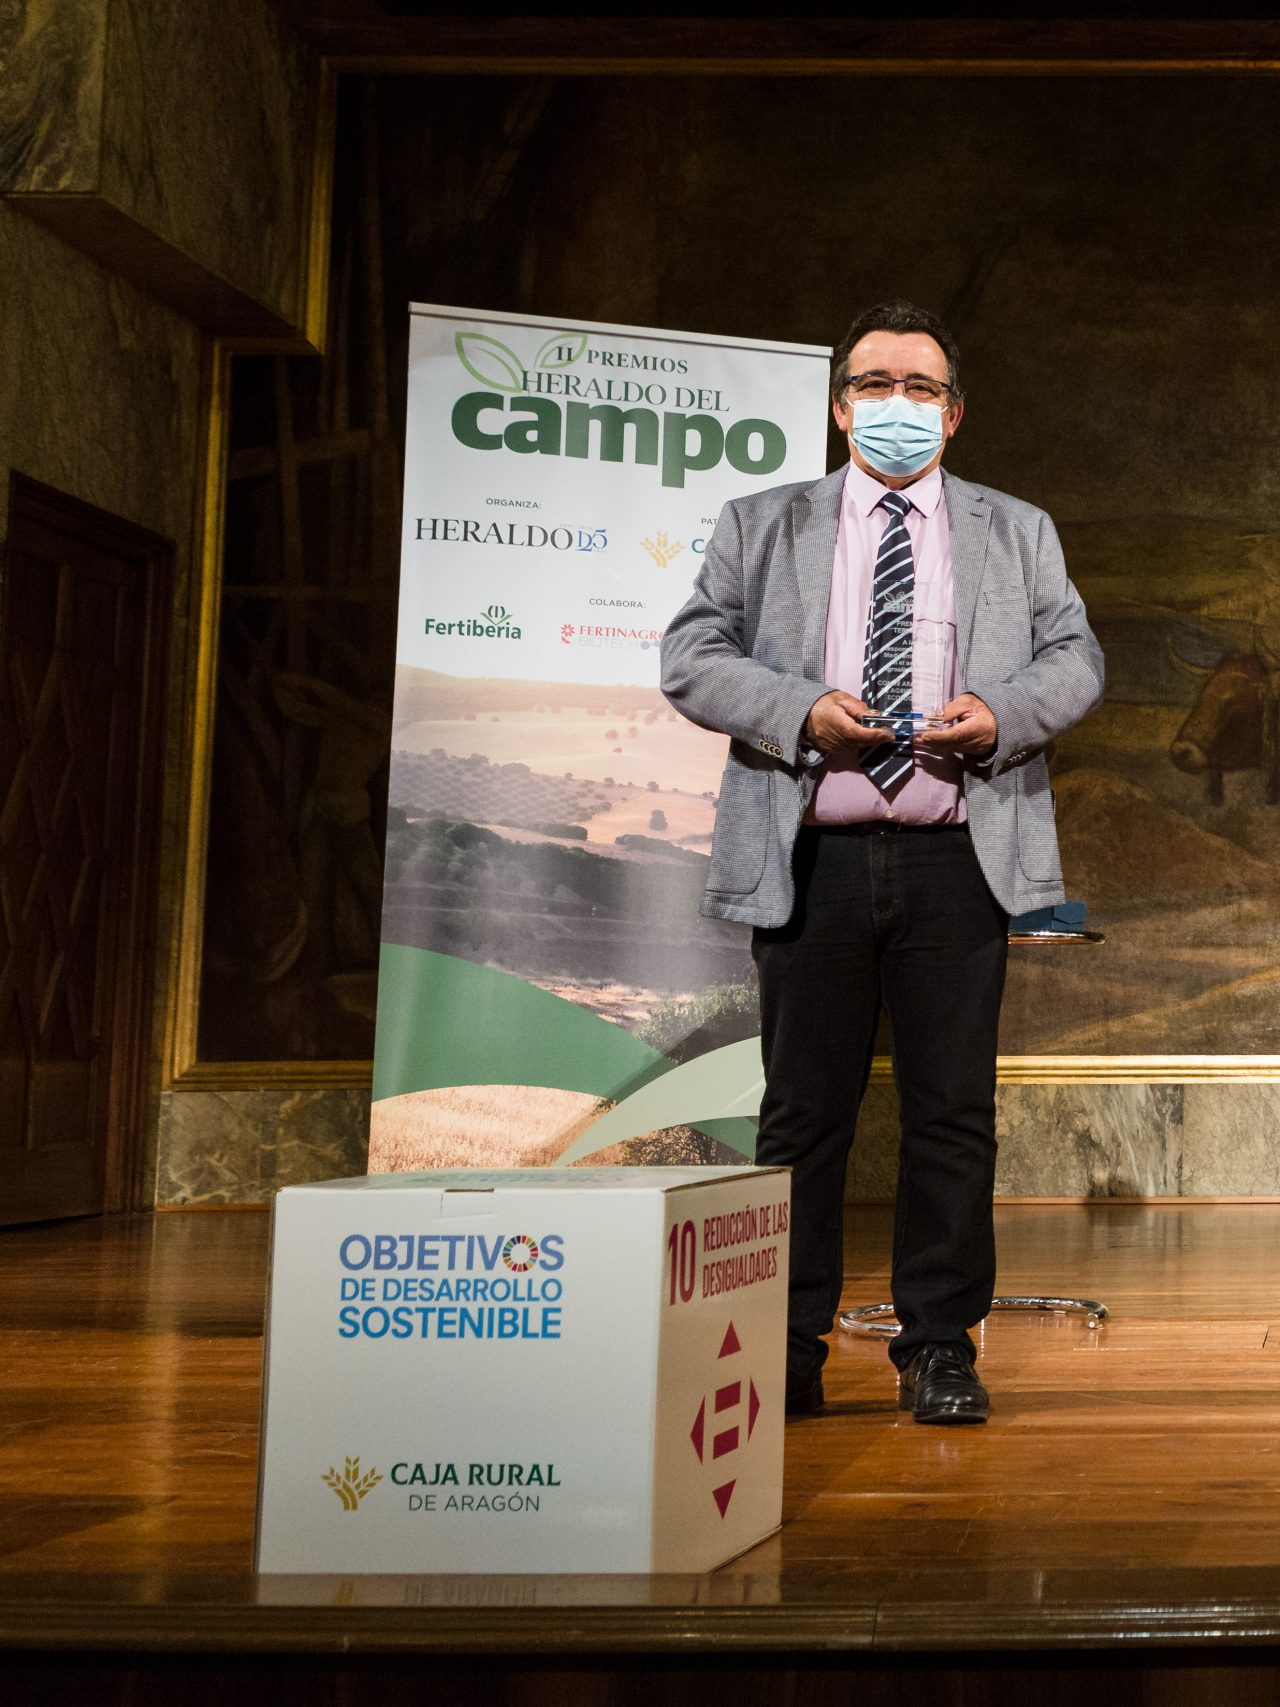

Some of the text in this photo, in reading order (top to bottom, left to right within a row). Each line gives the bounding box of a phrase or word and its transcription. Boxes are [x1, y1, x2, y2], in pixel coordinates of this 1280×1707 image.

[556, 346, 689, 374] II PREMIOS
[521, 371, 730, 413] HERALDO DEL
[451, 391, 787, 489] campo
[486, 498, 542, 509] ORGANIZA:
[415, 518, 573, 550] HERALDO
[589, 598, 646, 609] COLABORA:
[425, 618, 522, 639] Fertiberia
[339, 1234, 565, 1273] OBJETIVOS
[668, 1201, 788, 1306] 10 REDUCCIÓN DE LAS
[702, 1246, 777, 1299] DESIGUALDADES
[341, 1277, 563, 1302] DE DESARROLLO
[338, 1306, 562, 1340] SOSTENIBLE
[390, 1462, 562, 1487] CAJA RURAL
[408, 1491, 540, 1512] DE ARAGÓN
